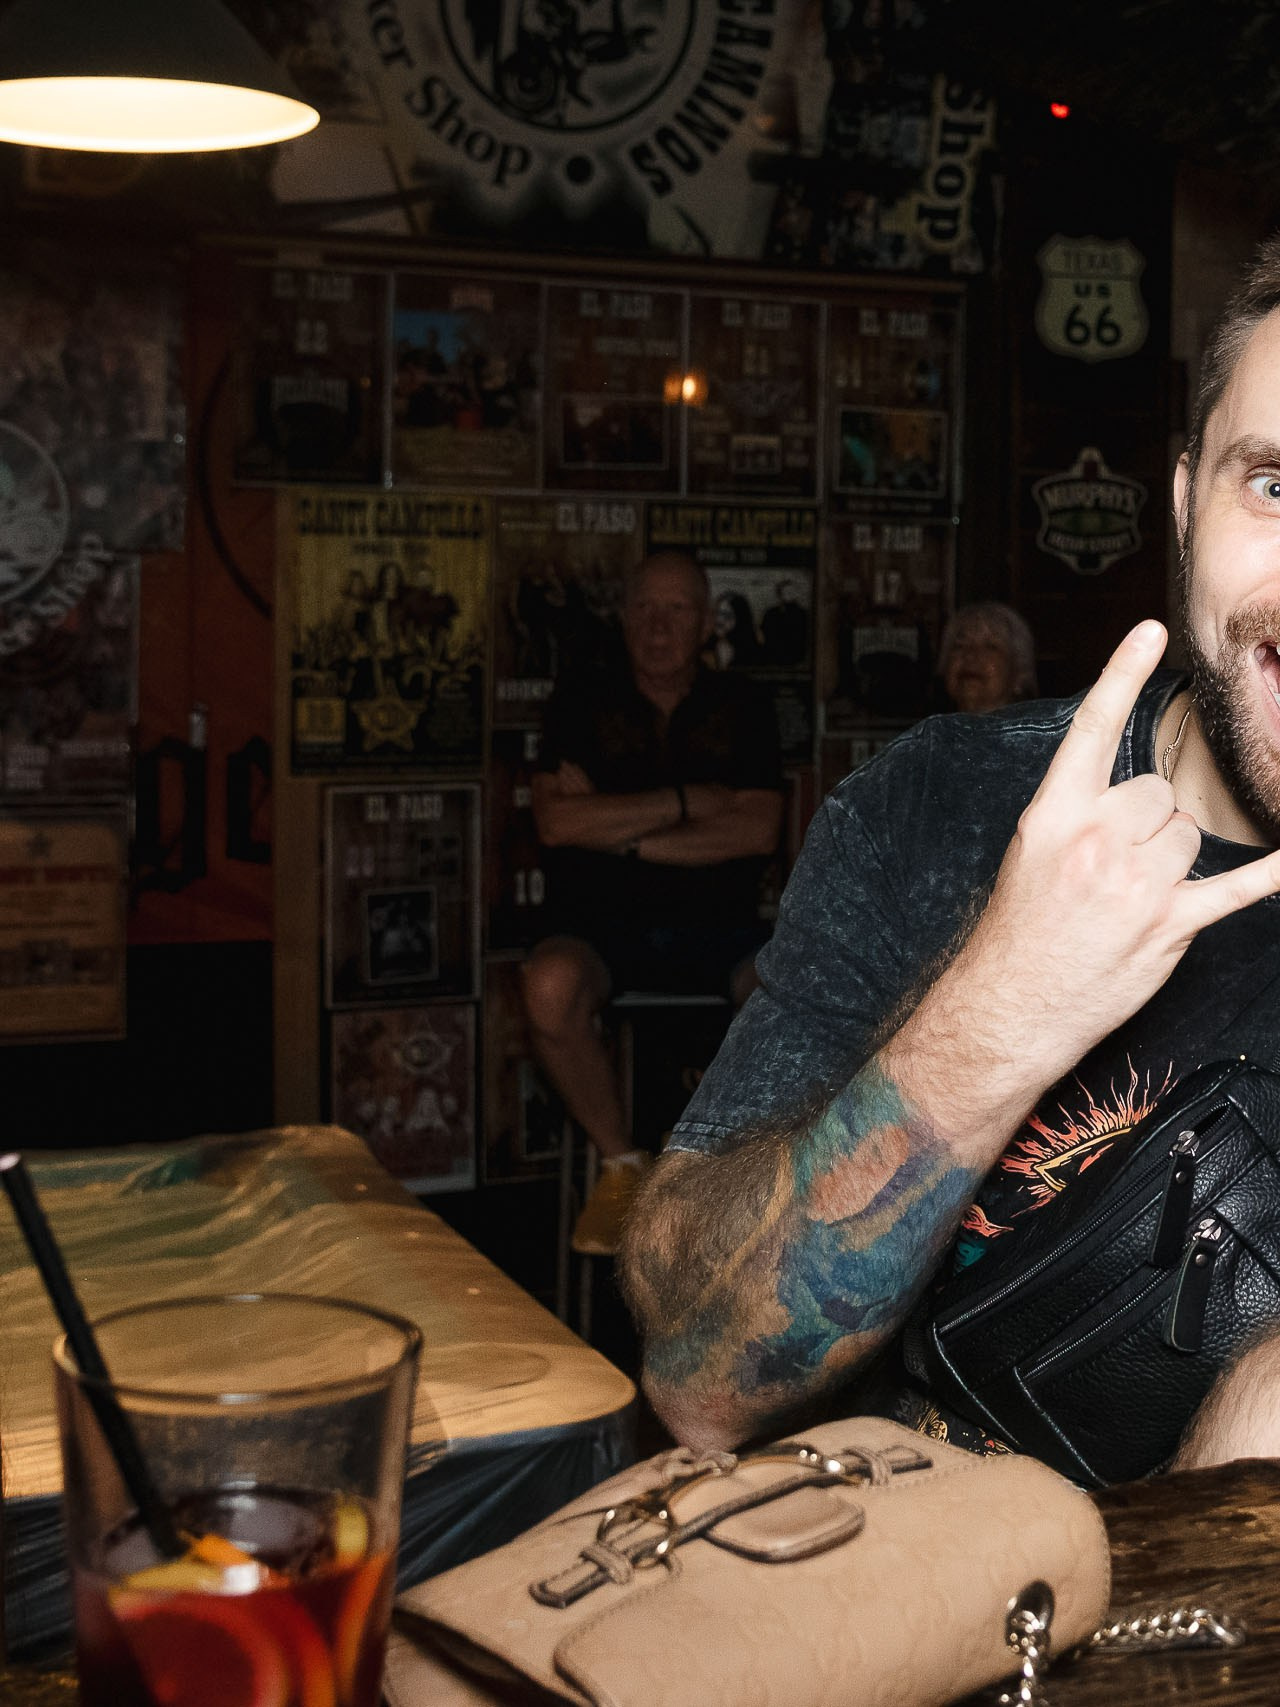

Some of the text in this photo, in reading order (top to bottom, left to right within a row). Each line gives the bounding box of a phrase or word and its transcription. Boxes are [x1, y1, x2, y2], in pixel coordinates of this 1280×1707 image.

[404, 75, 533, 188] Shop
[918, 78, 986, 241] Shop
[1062, 250, 1122, 274] TEXAS
[1064, 304, 1122, 347] 66
[582, 503, 637, 534] PASO
